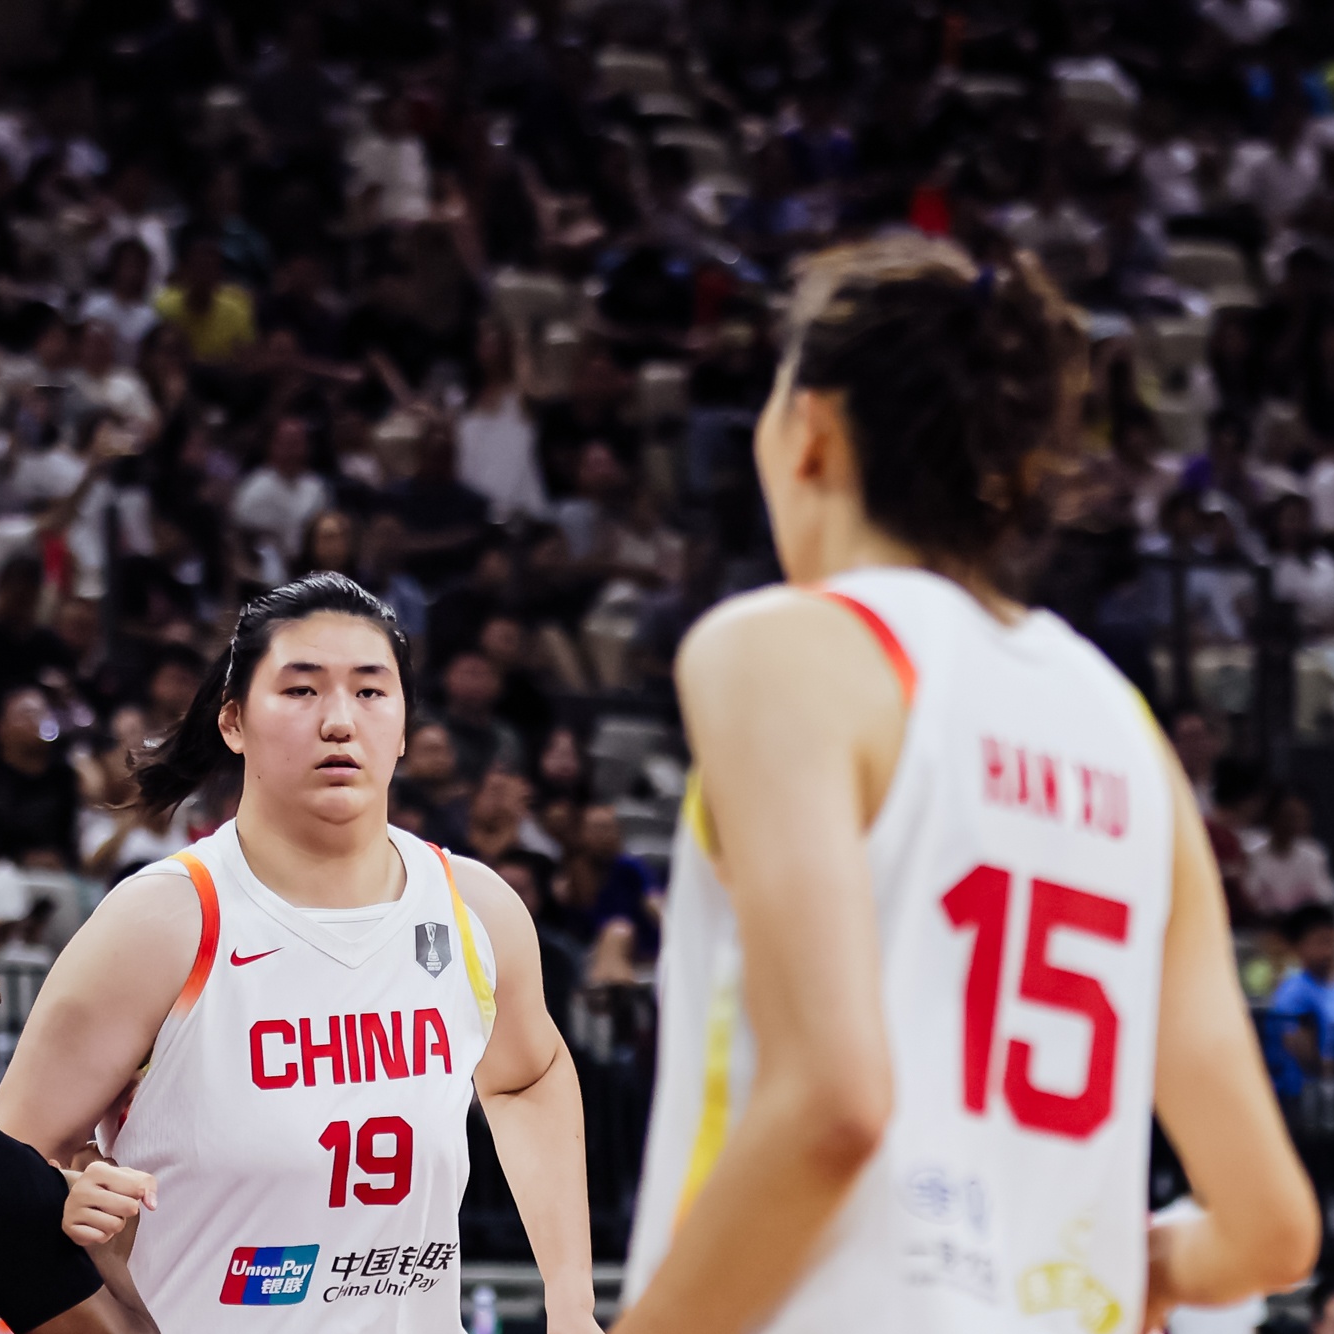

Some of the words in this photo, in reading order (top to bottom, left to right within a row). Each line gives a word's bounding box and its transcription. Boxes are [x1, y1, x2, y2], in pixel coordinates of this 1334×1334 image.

[940, 863, 1130, 1143] 15
[249, 1008, 452, 1090] CHINA
[318, 1116, 413, 1208] 19
[231, 1260, 312, 1282] UnionPay
[261, 1277, 304, 1295] 银联
